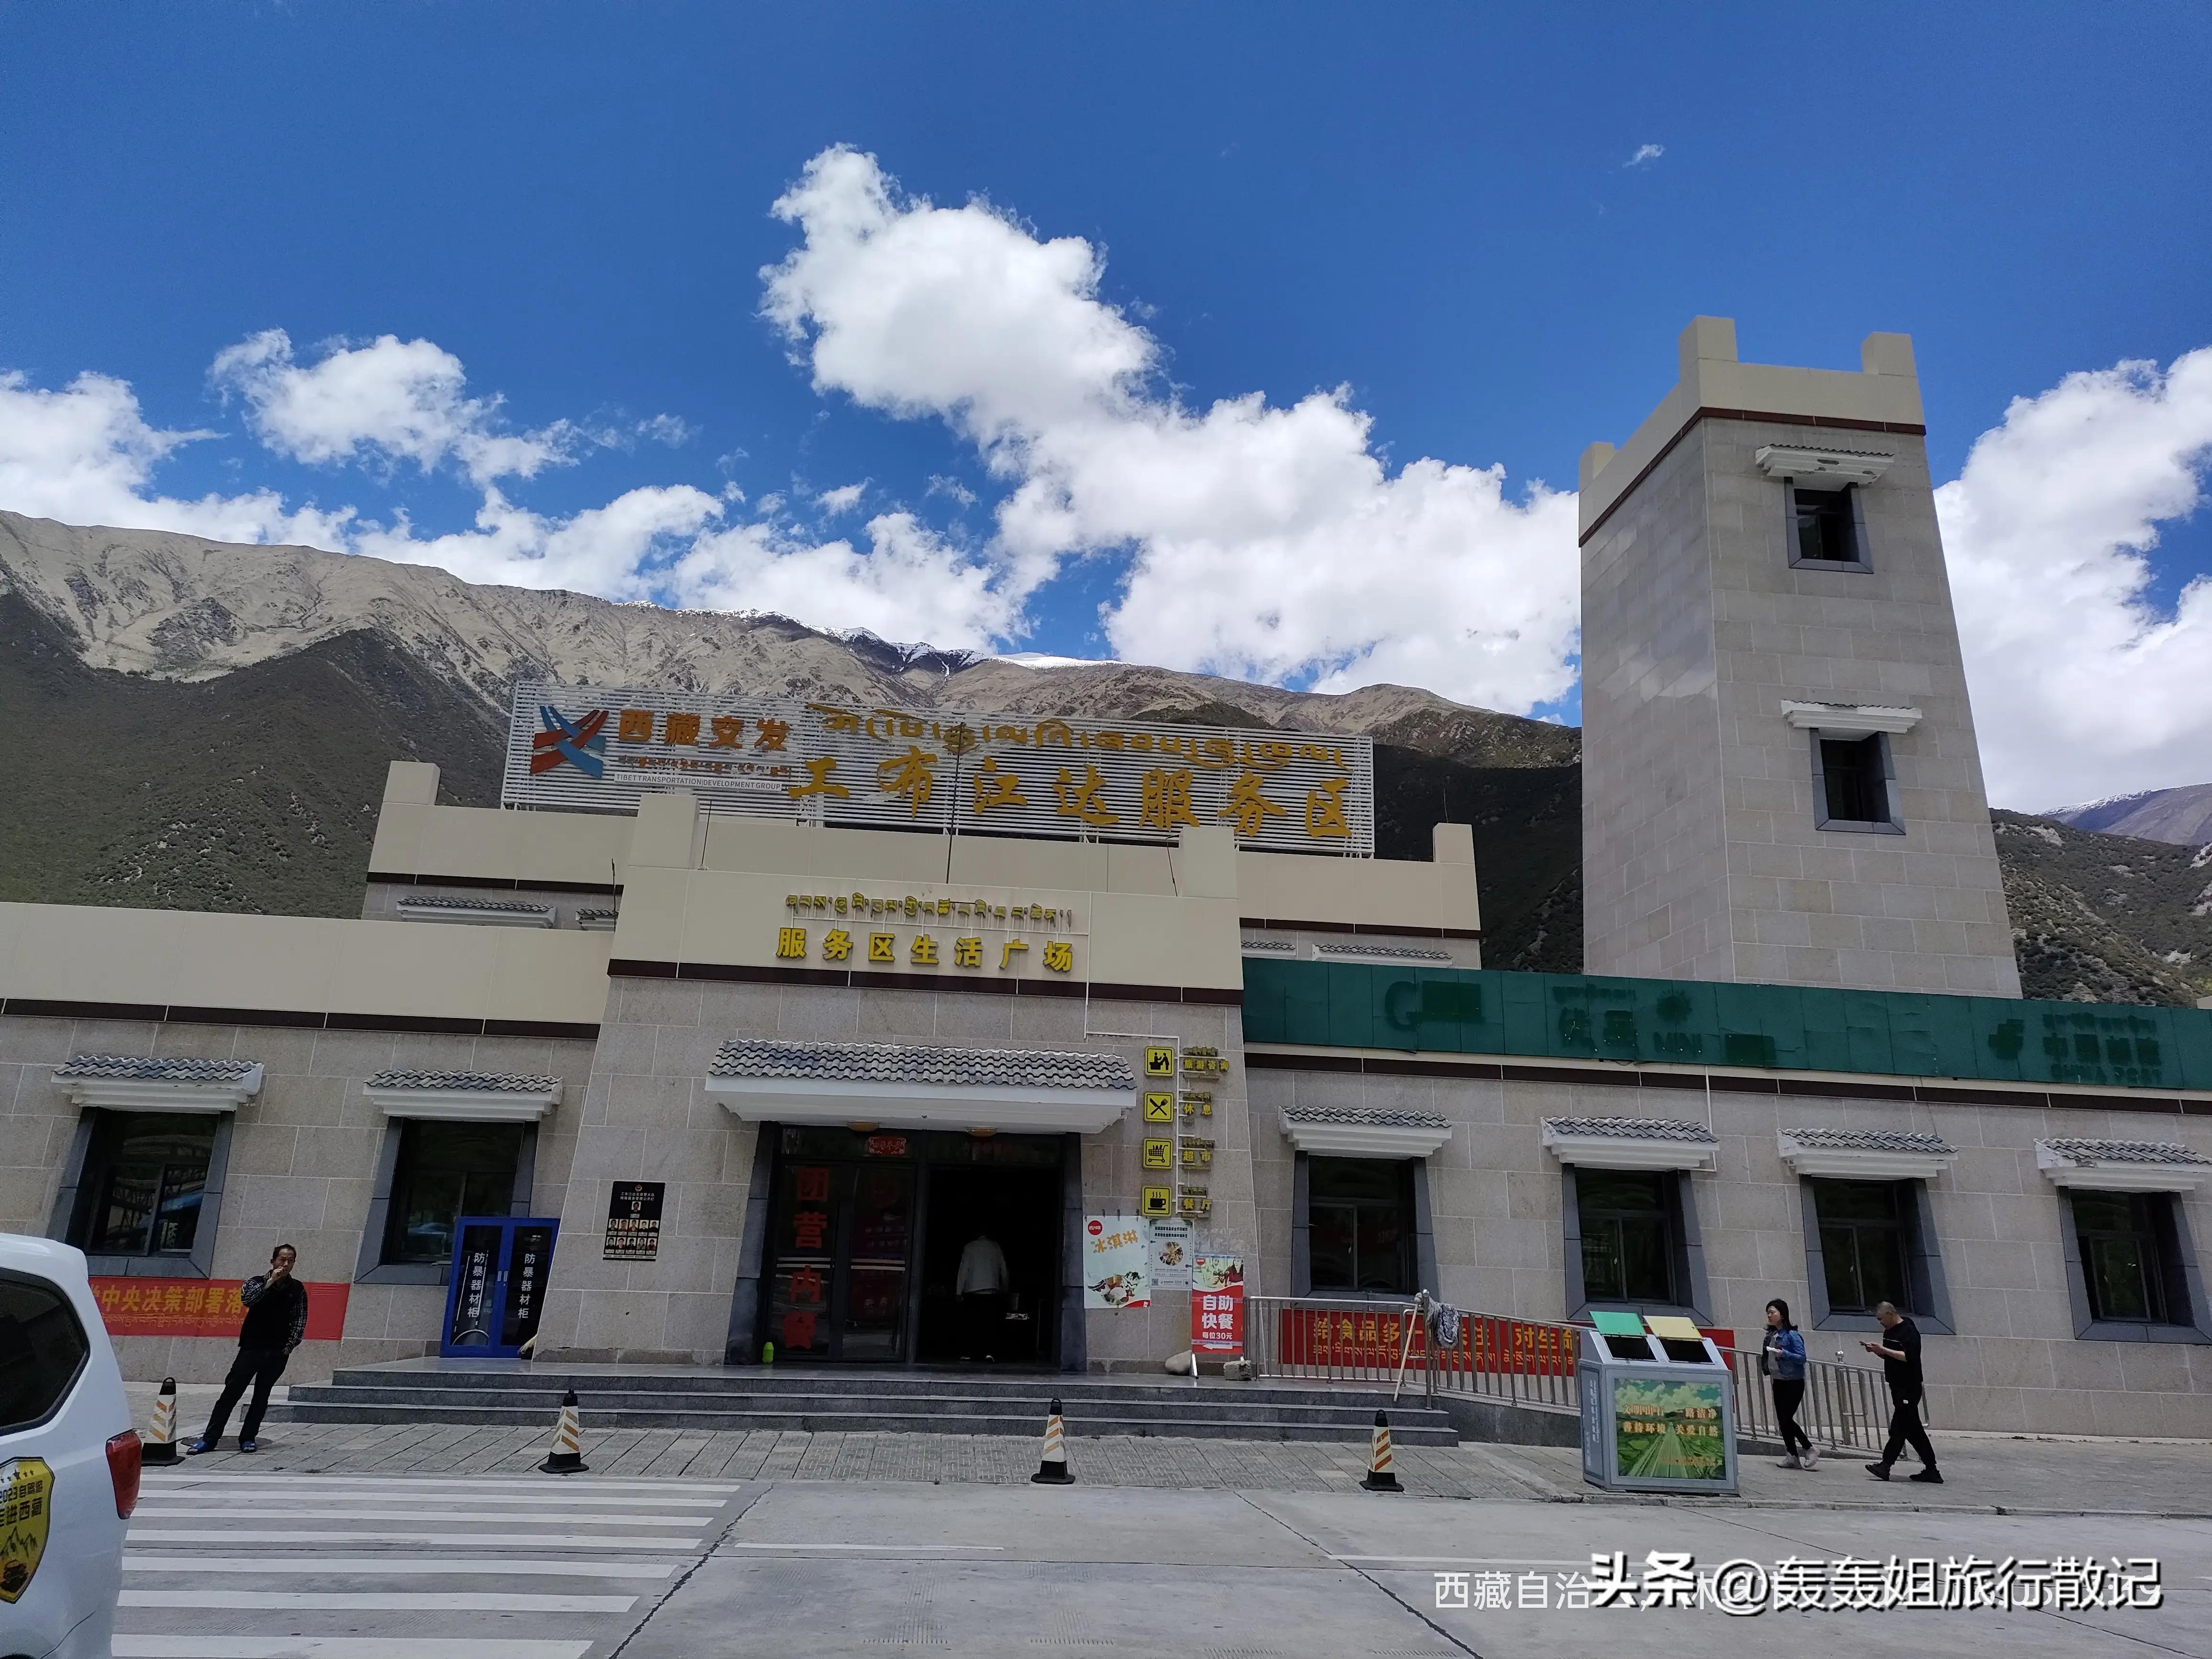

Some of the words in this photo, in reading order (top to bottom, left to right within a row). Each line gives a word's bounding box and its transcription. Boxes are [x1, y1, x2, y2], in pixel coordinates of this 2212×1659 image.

[619, 709, 791, 751] 西藏交发
[638, 775, 702, 785] TRANSPORTATION
[703, 779, 755, 788] DEVELOPMENT
[788, 745, 1353, 837] 工布江达服务区
[776, 927, 1073, 972] 服务区生活广场
[1184, 1058, 1228, 1072] 旅游咨询
[1183, 1103, 1212, 1116] 休息
[1183, 1150, 1212, 1162] 超市
[1183, 1198, 1212, 1210] 餐厅
[467, 1252, 486, 1318] 防暴器材柜
[518, 1253, 535, 1319] 防暴器材柜
[91, 1284, 250, 1314] 中央决策部署落
[1203, 1294, 1233, 1311] 自助
[1202, 1313, 1233, 1330] 快餐
[1202, 1332, 1233, 1340] 每位30元
